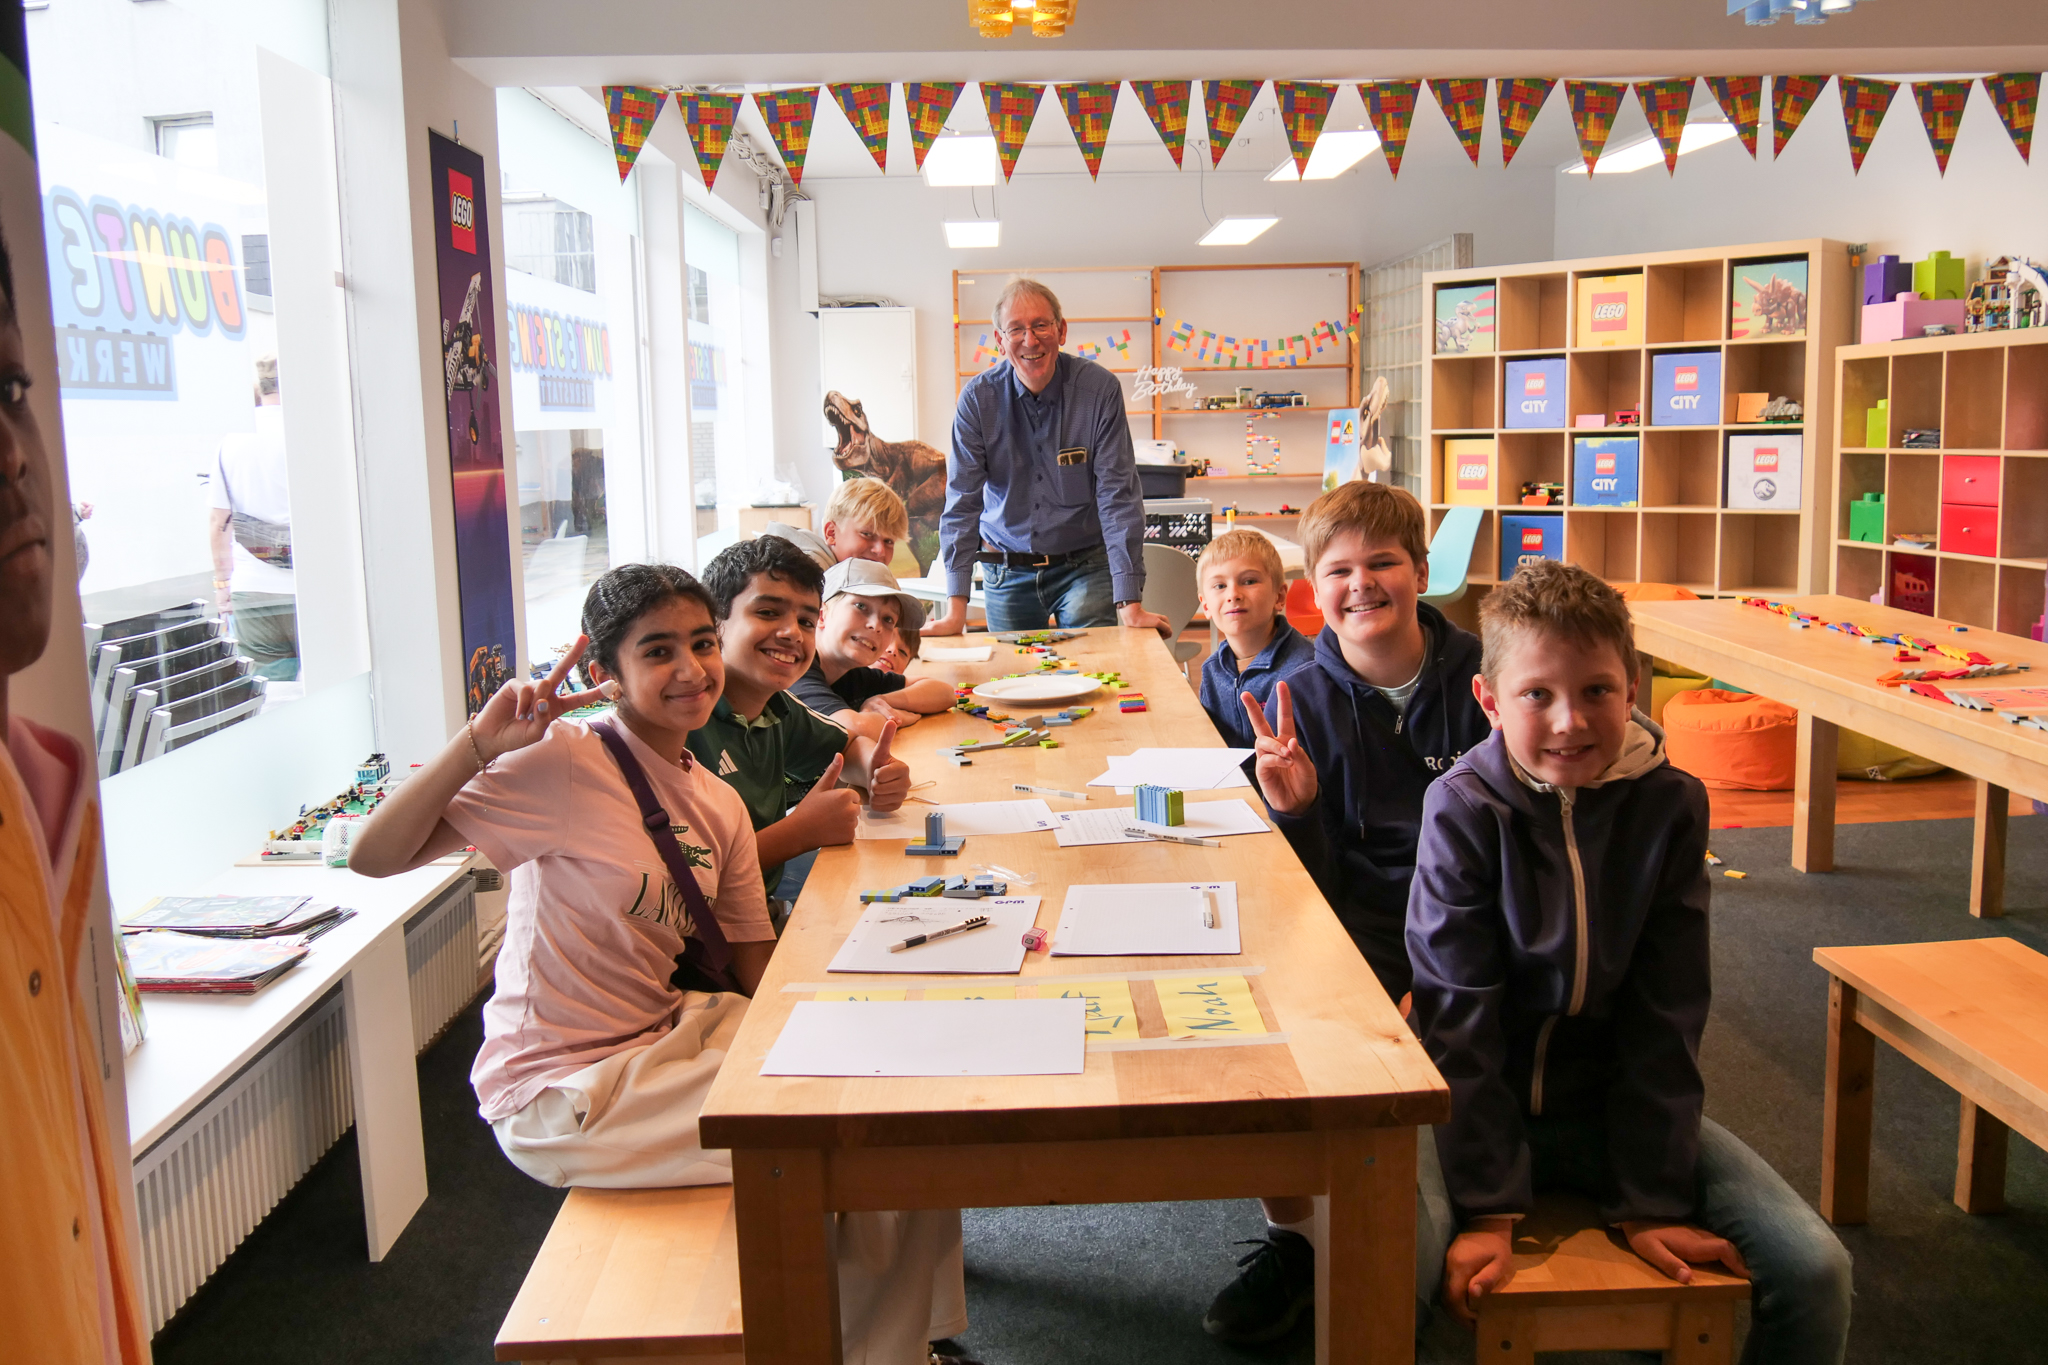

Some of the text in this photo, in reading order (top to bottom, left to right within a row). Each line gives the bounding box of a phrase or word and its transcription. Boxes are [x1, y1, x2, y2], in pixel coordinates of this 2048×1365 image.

[452, 192, 474, 231] LEGO
[1593, 302, 1626, 321] LEGO
[1133, 365, 1183, 385] Happy
[1675, 372, 1698, 384] LEGO
[1131, 377, 1198, 402] Birthday
[1526, 378, 1545, 390] LEGO
[1521, 400, 1548, 413] CITY
[1670, 395, 1701, 409] CITY
[1597, 458, 1616, 469] LEGO
[1755, 454, 1778, 466] LEGO
[1458, 464, 1487, 480] LEGO
[1591, 478, 1618, 491] CITY
[1523, 533, 1542, 544] LEGO
[1178, 981, 1242, 1031] Noah
